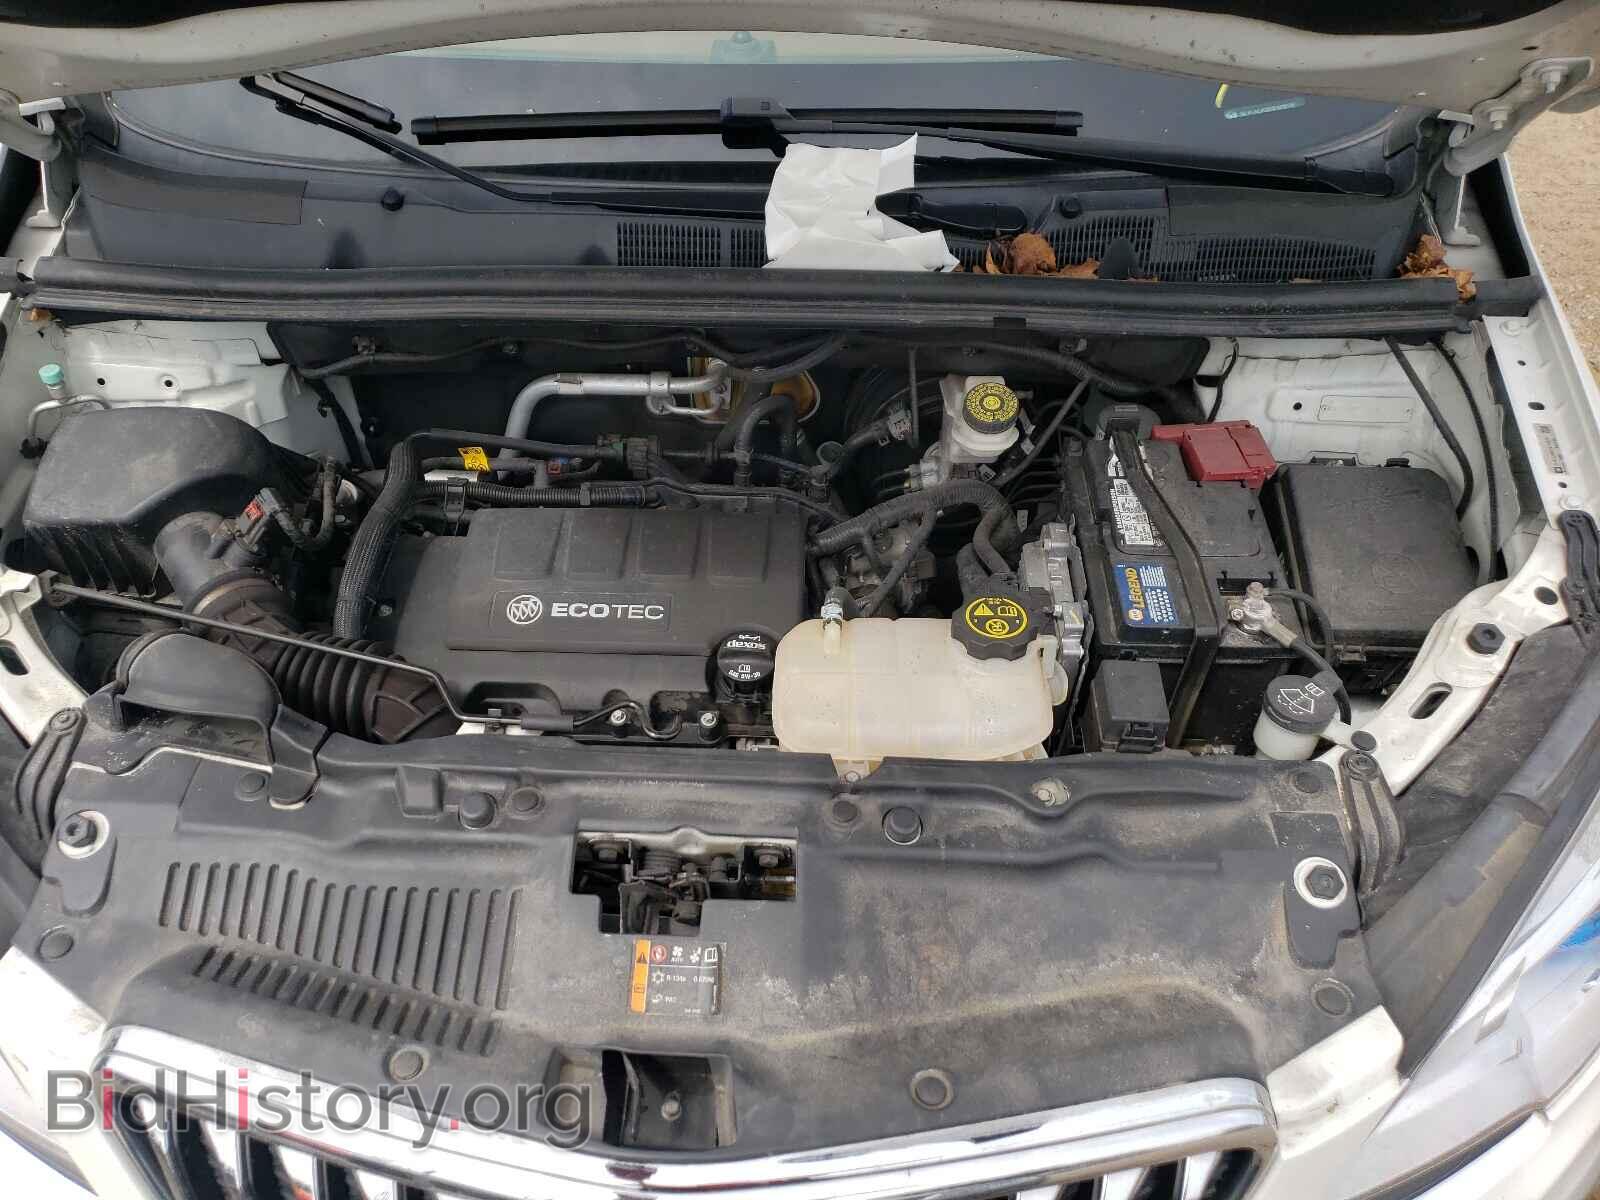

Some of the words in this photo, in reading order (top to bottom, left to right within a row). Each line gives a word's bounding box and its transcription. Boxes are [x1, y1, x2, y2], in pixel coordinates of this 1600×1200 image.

[1125, 567, 1145, 609] LEGEND
[551, 602, 665, 620] ECOTEC
[727, 639, 767, 650] dexos
